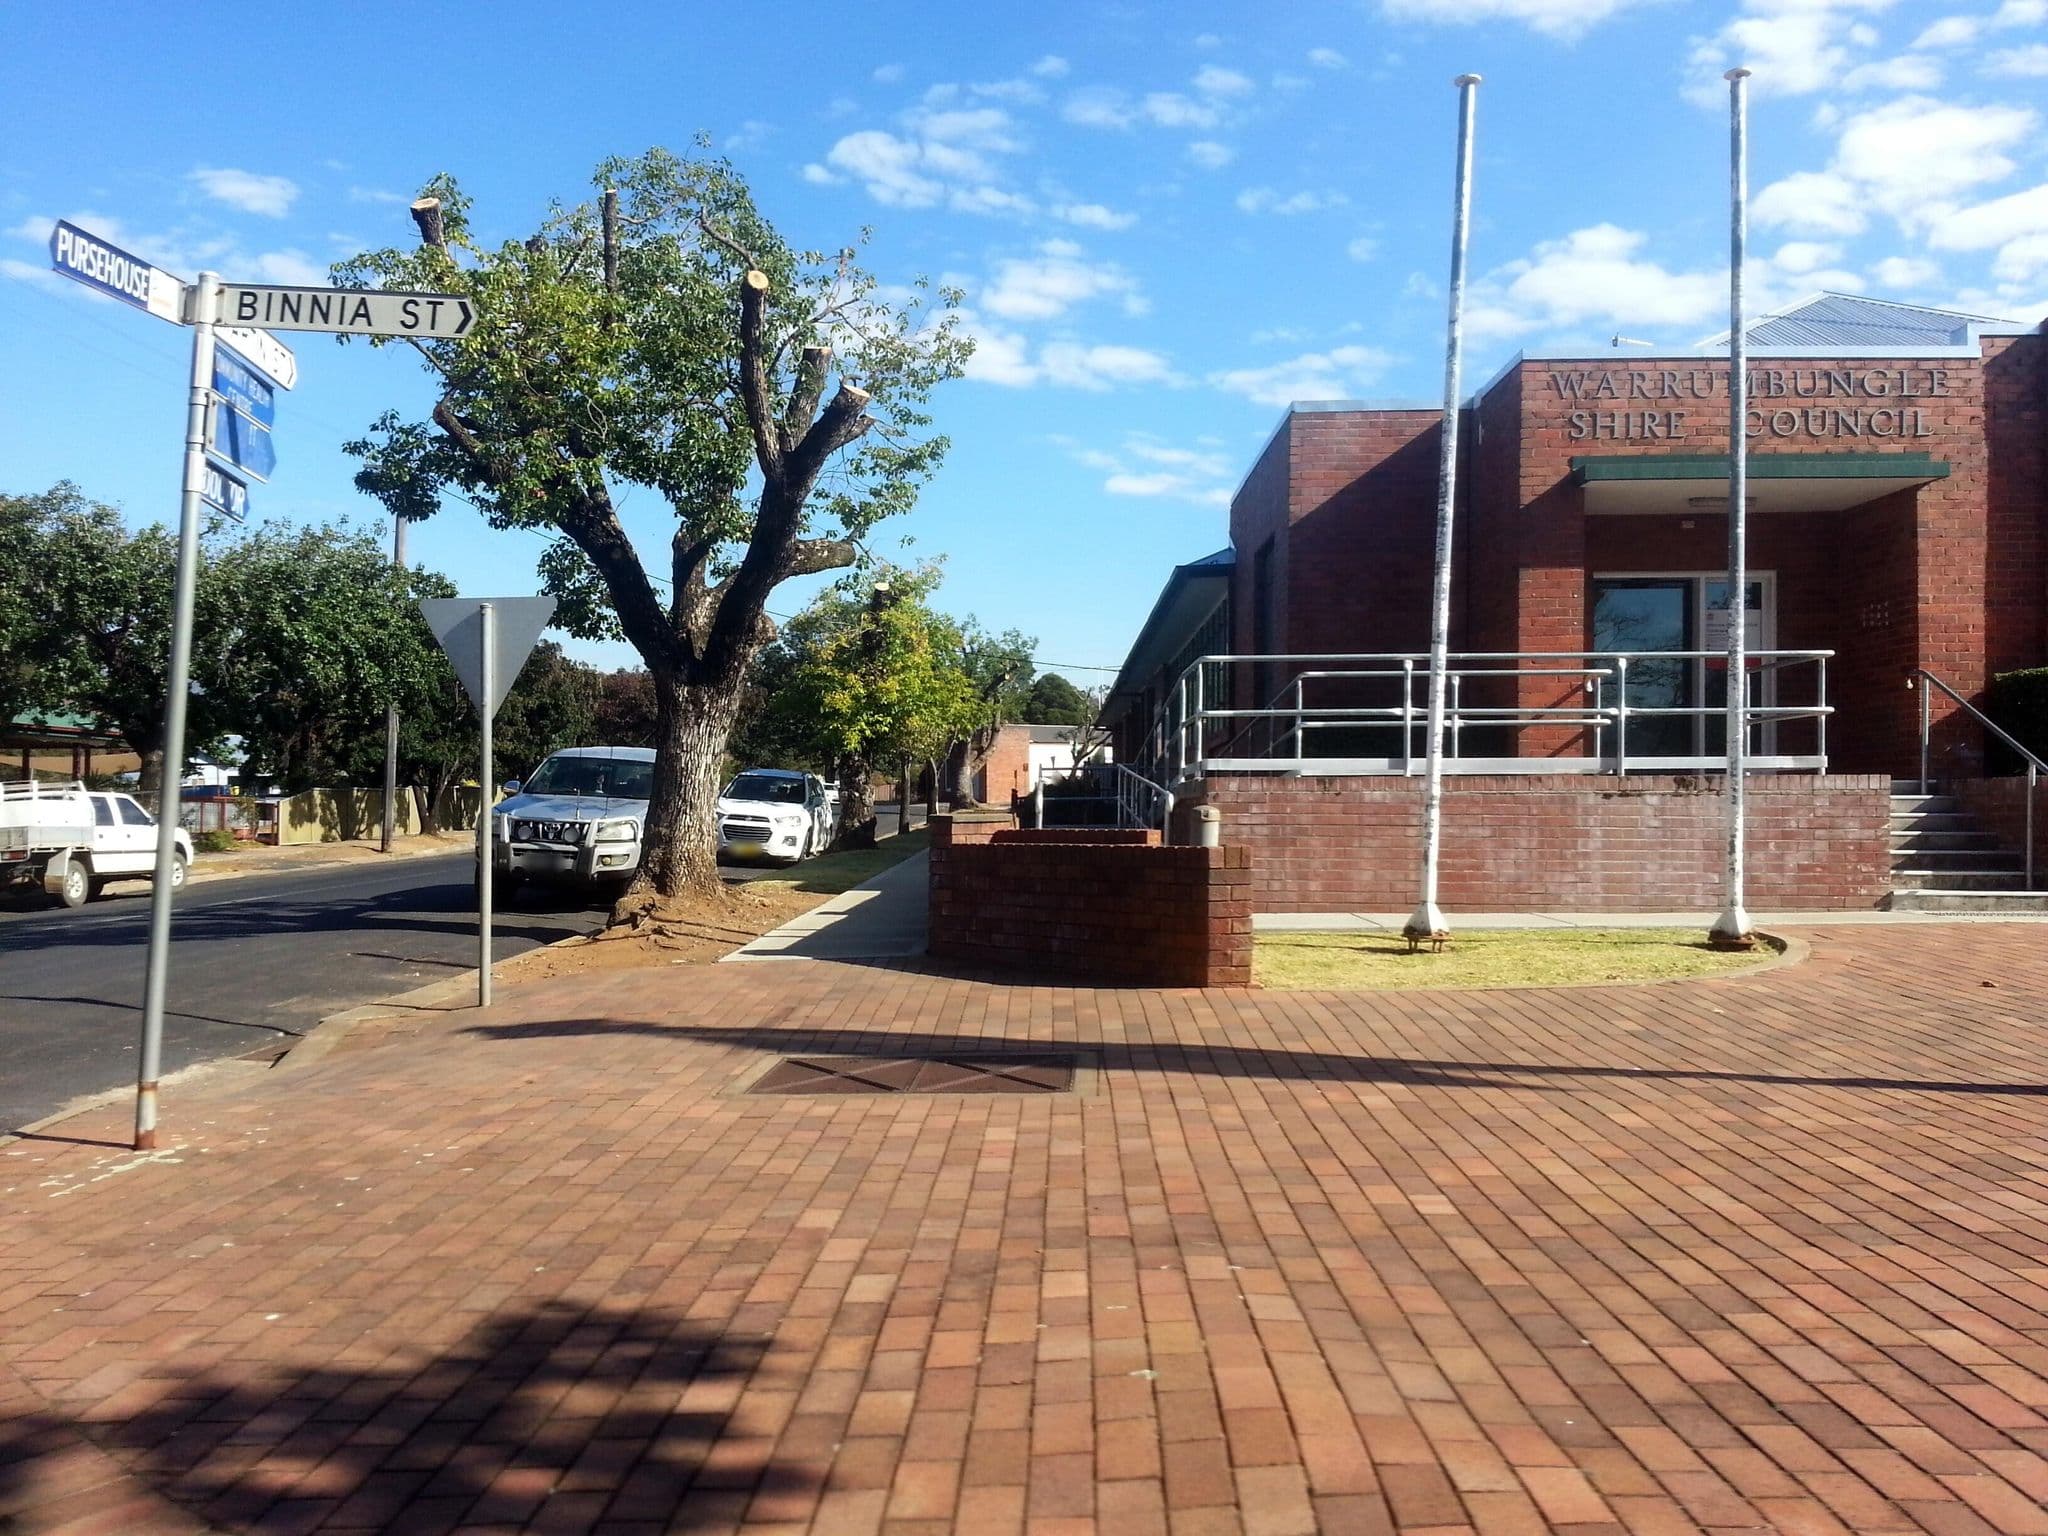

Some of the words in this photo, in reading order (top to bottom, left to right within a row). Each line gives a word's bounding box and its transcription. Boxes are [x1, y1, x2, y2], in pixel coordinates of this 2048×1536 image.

[57, 227, 150, 301] PURSEHOUSE
[237, 290, 372, 327] BINNIA
[400, 298, 444, 331] ST
[1550, 368, 1950, 400] WARRUMBUNGLE
[1569, 410, 1689, 440] SHIRE
[1743, 408, 1935, 439] COUNCIL
